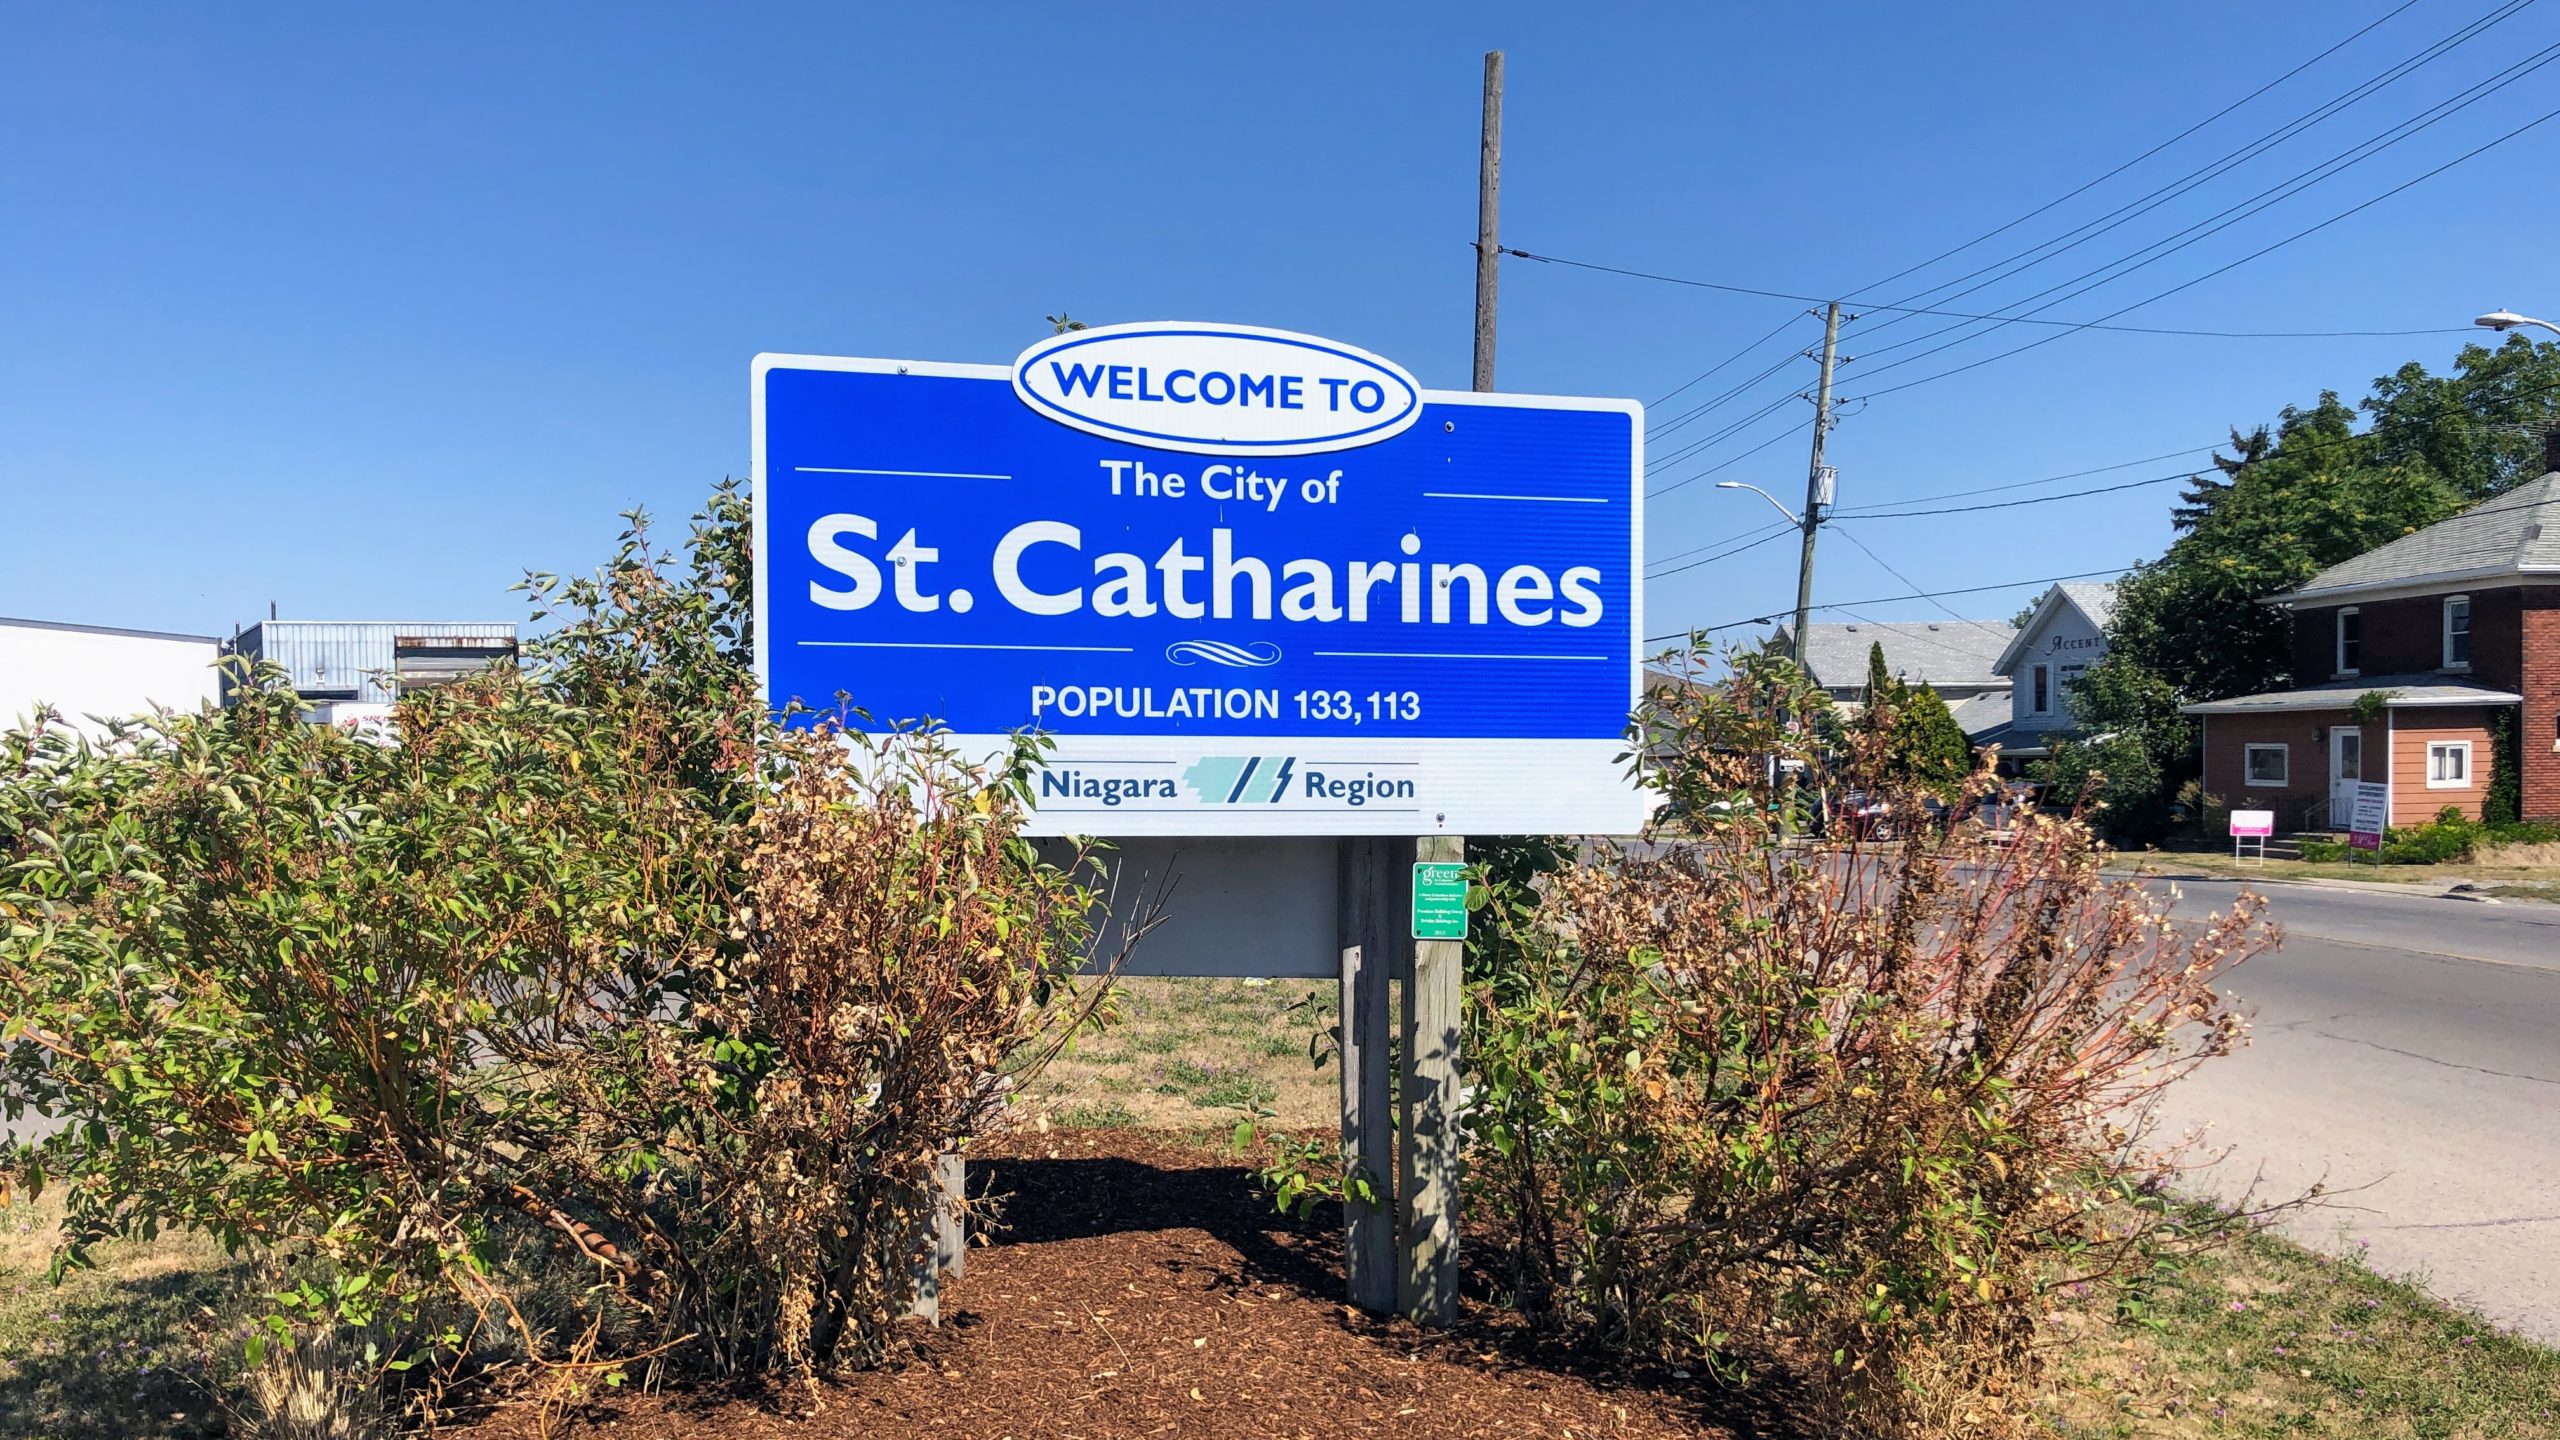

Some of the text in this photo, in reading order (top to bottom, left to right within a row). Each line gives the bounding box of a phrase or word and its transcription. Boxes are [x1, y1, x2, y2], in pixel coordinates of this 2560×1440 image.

[1050, 361, 1386, 414] WELCOME TO
[1100, 459, 1343, 512] The City of
[806, 512, 1603, 627] St. Catharines
[1031, 685, 1421, 726] POPULATION 133,113
[1041, 770, 1415, 806] Niagara Region
[1423, 867, 1458, 886] green
